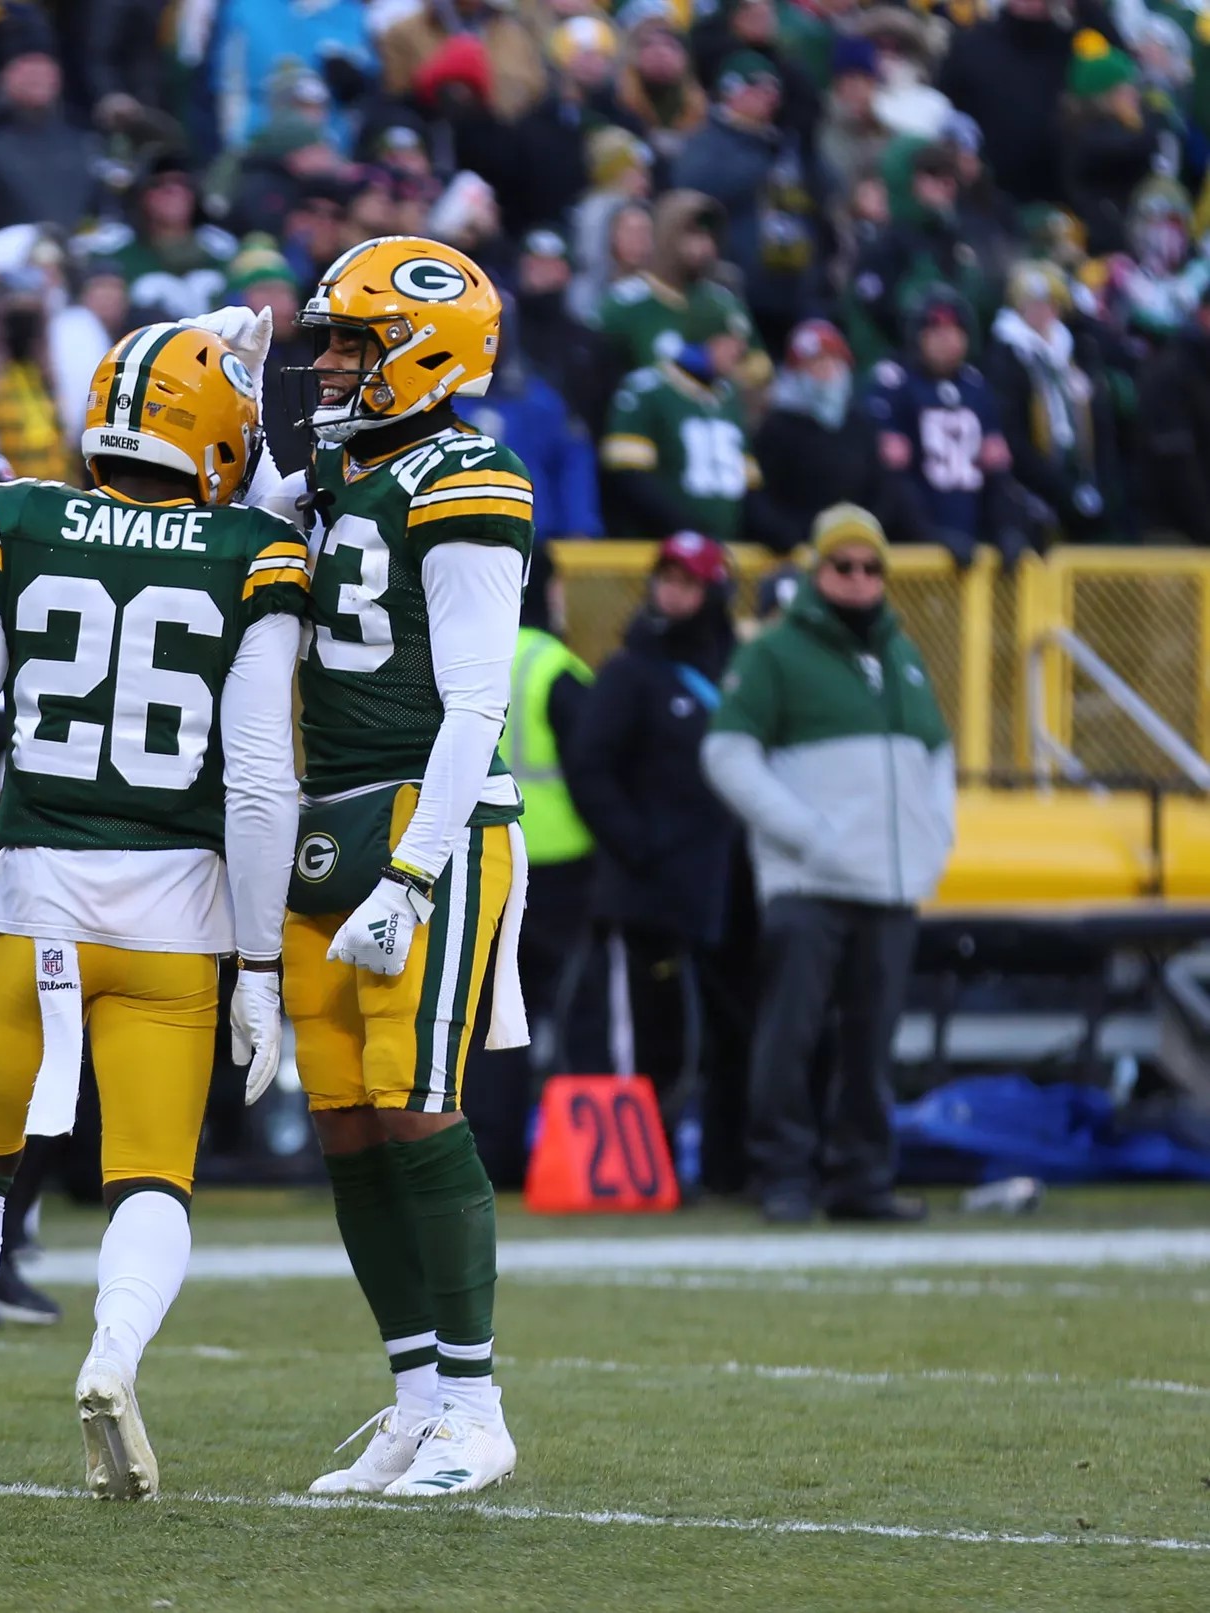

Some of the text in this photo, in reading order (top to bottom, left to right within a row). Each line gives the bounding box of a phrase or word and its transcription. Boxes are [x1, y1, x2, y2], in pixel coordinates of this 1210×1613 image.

[392, 258, 465, 301] G
[119, 398, 129, 408] 15
[100, 434, 140, 451] PACKERS
[61, 498, 213, 552] SAVAGE
[299, 512, 394, 673] 3
[11, 573, 225, 791] 26
[298, 836, 336, 879] G
[385, 913, 399, 955] adidas
[38, 980, 73, 991] Wilson
[44, 960, 61, 973] NFL
[571, 1094, 659, 1197] 20
